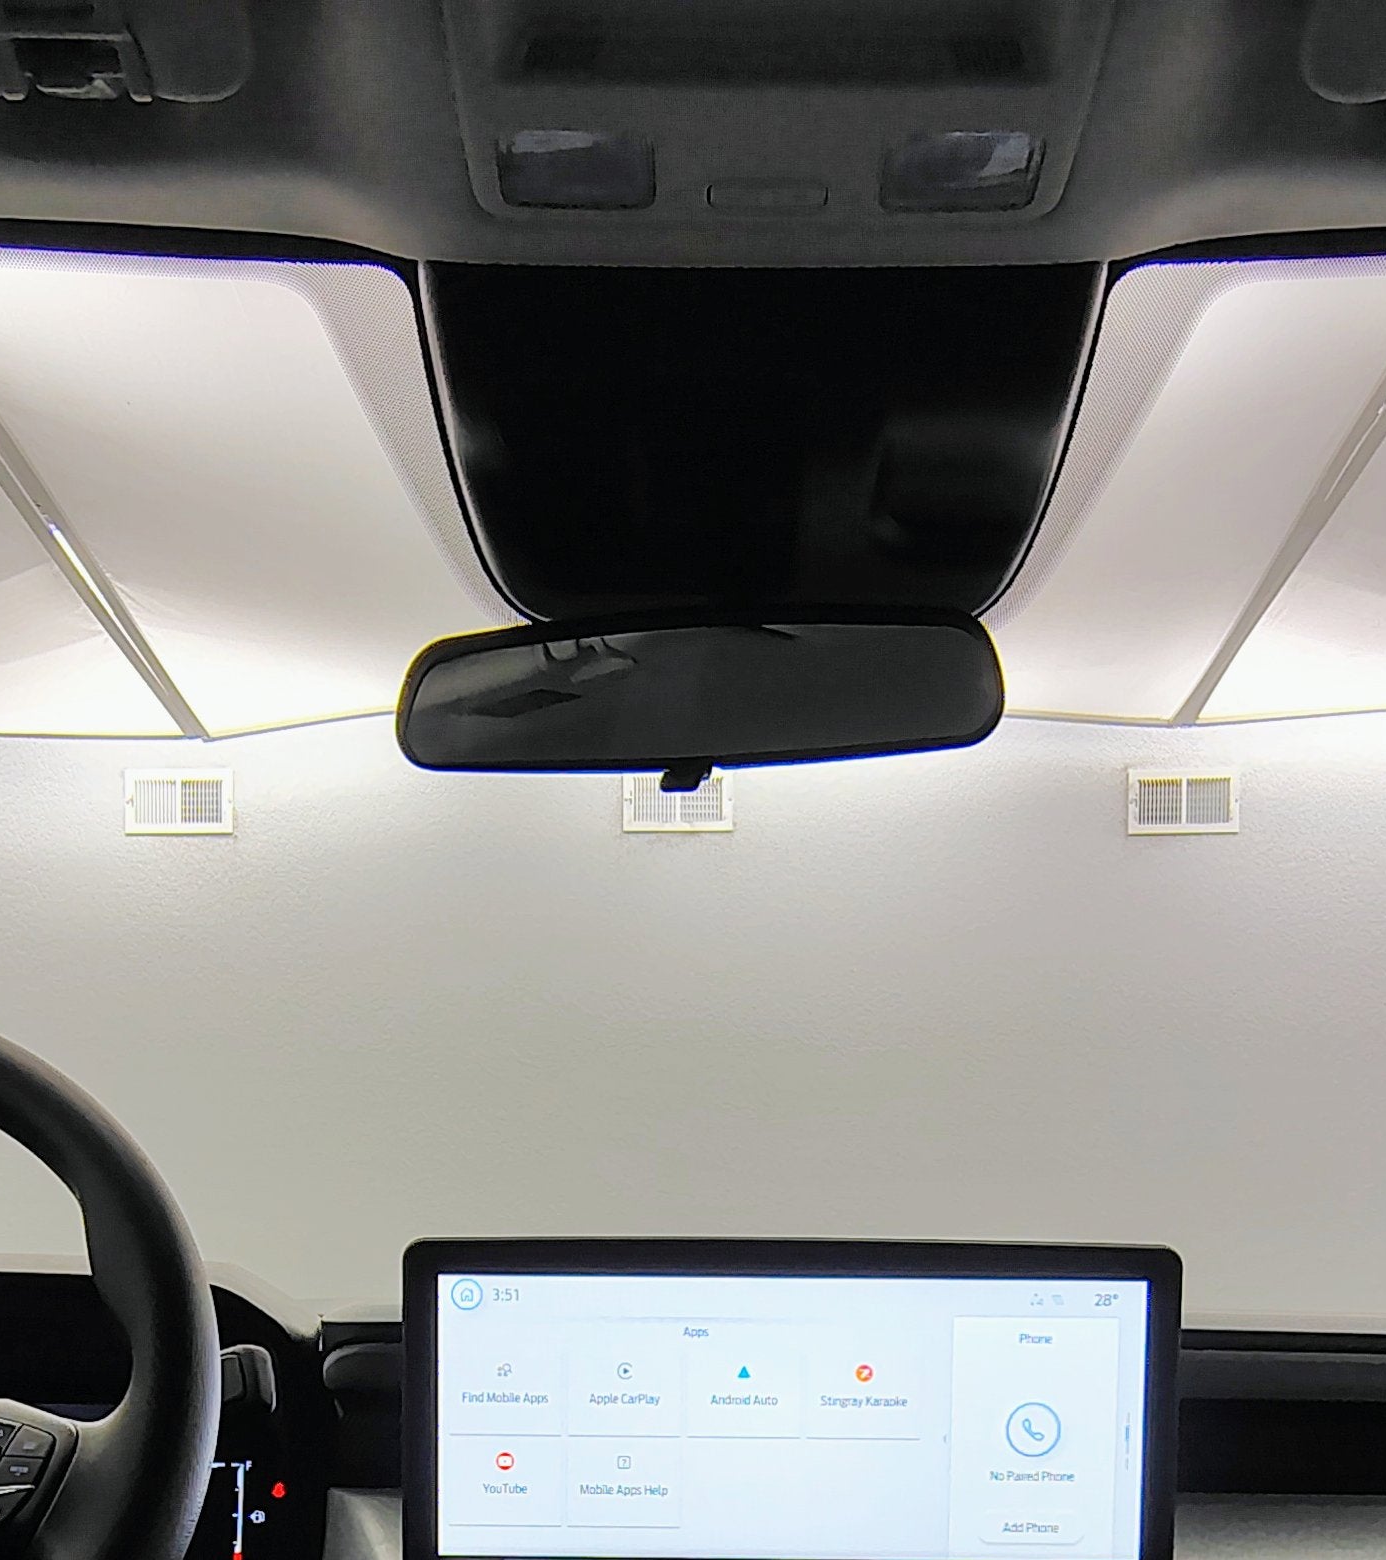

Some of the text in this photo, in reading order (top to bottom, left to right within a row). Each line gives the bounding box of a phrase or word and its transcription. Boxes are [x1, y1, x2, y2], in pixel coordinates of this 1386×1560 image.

[492, 1288, 520, 1302] 3:51
[1094, 1293, 1119, 1307] 28°
[683, 1327, 709, 1338] Apps
[1019, 1333, 1053, 1345] Phone
[462, 1391, 549, 1405] Find Mobile Apps
[589, 1393, 660, 1406] Apple CarPlay
[710, 1394, 778, 1406] Android Auto
[820, 1395, 908, 1408] Stingray Karaoke
[990, 1470, 1075, 1482] No Paired Phone
[482, 1483, 528, 1495] YouTube
[579, 1484, 669, 1497] Mobile Apps Help
[1002, 1522, 1060, 1534] Add Phone
